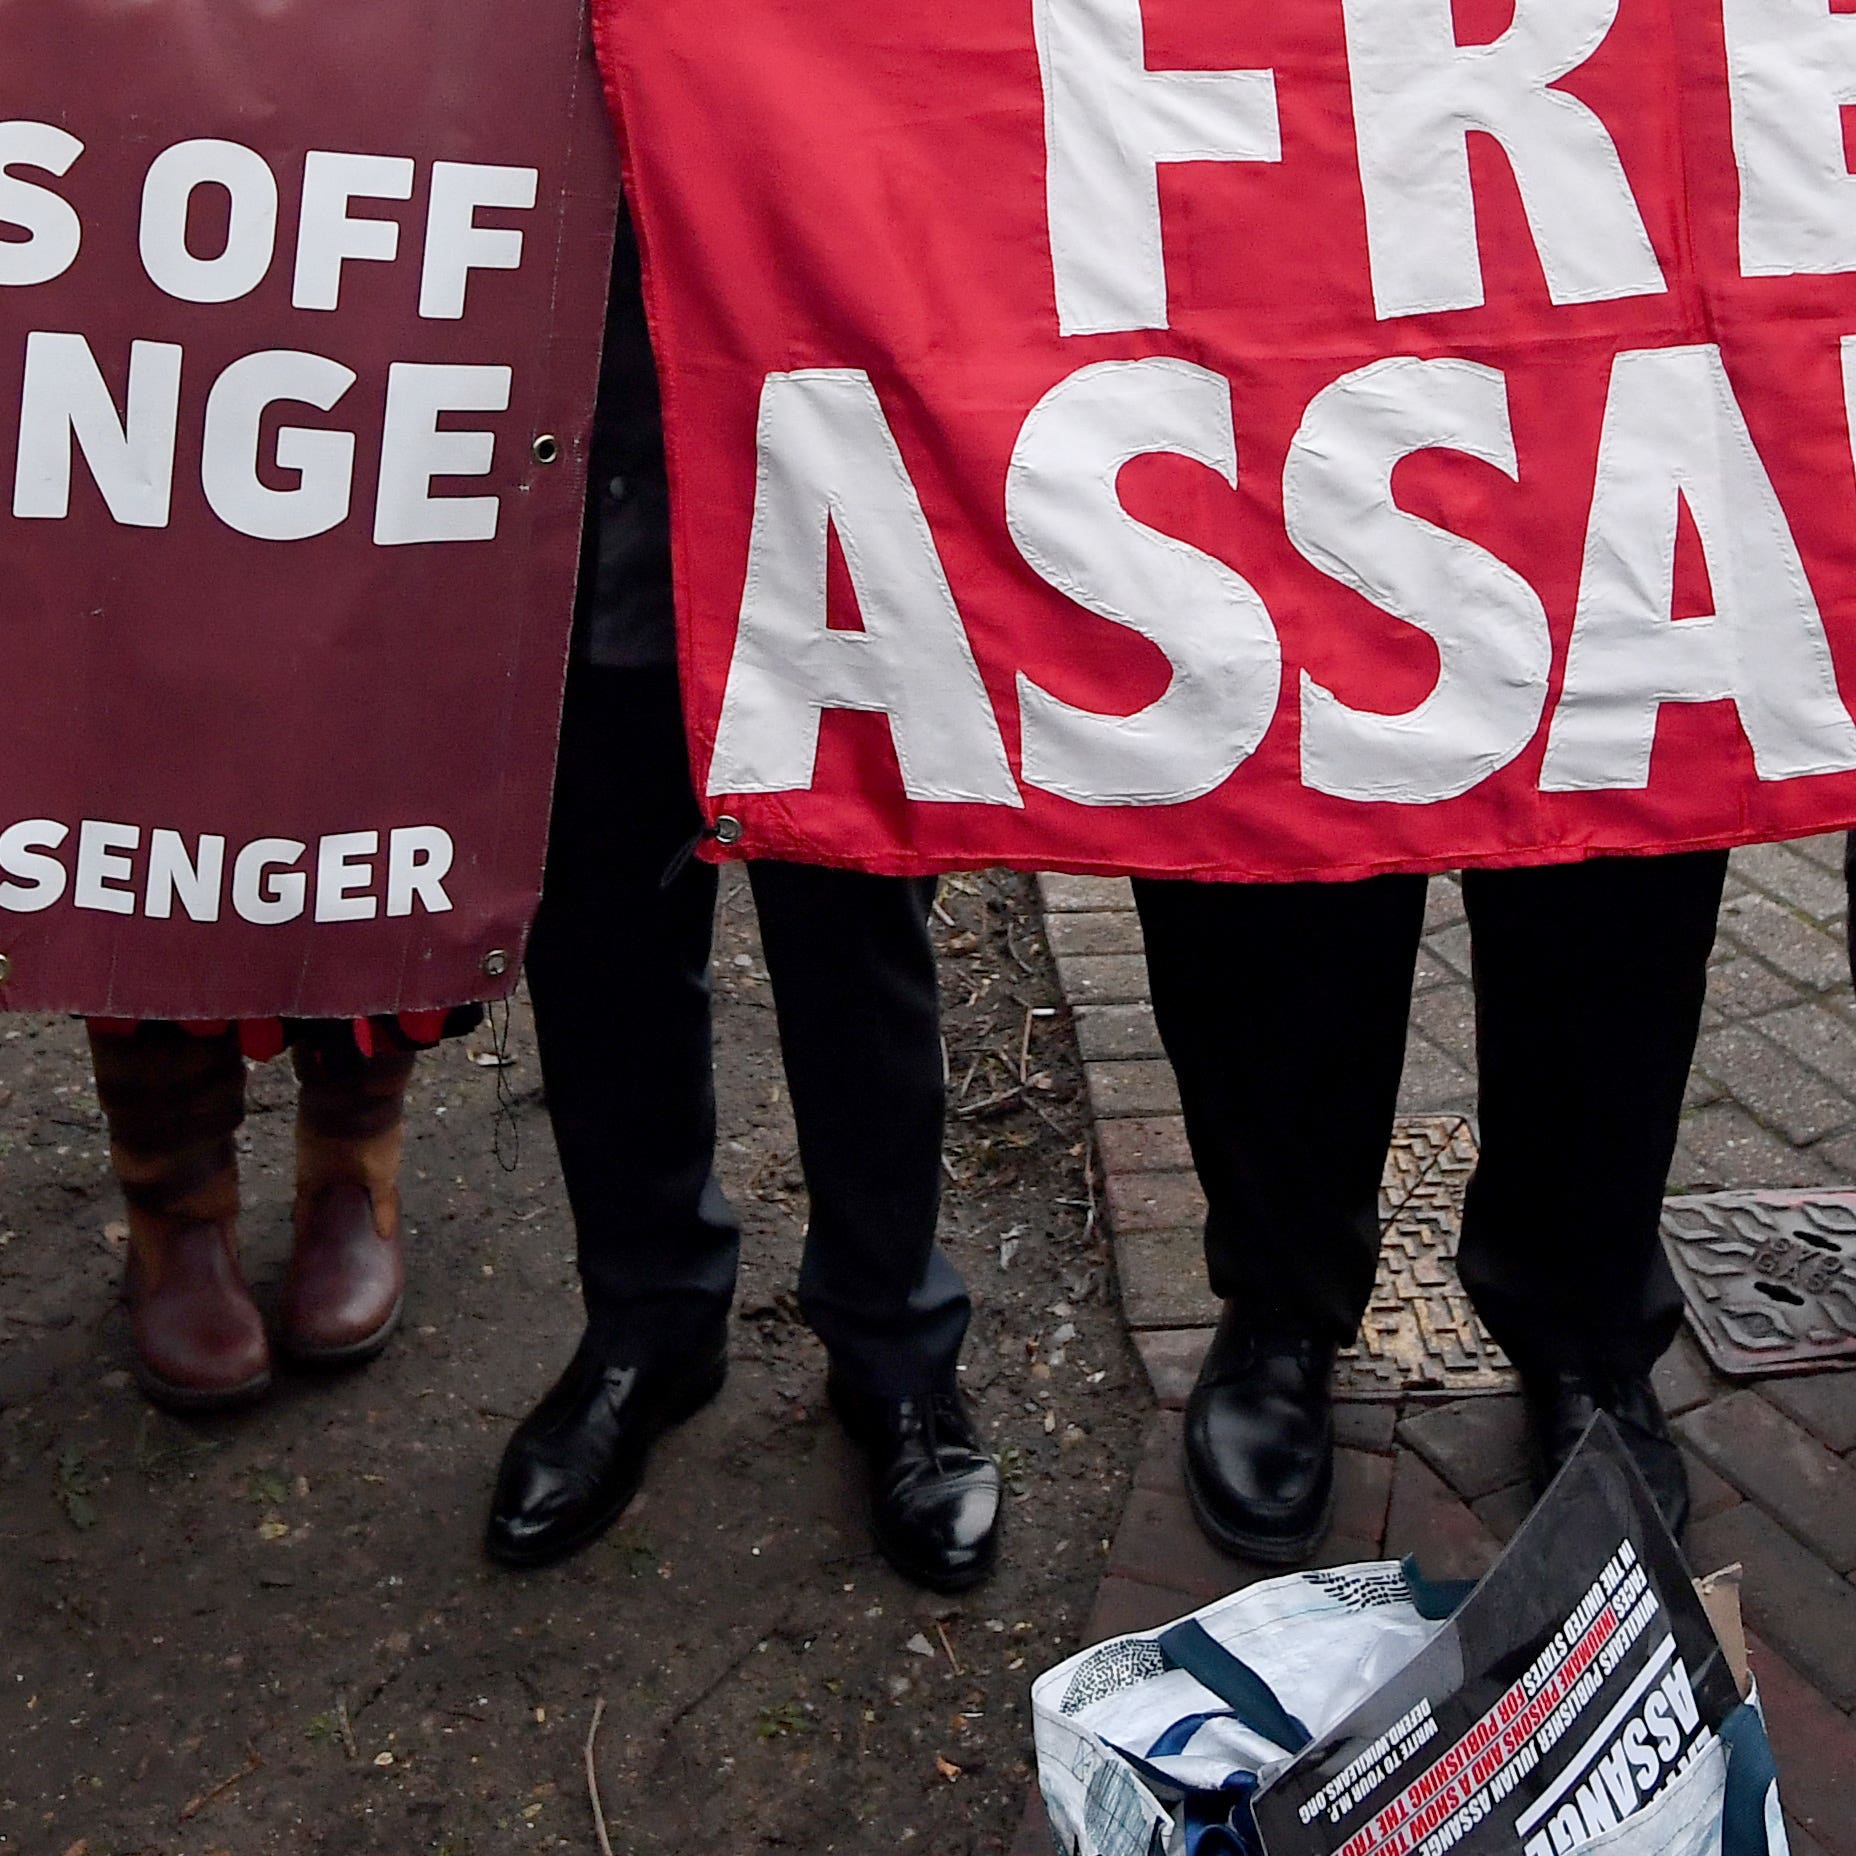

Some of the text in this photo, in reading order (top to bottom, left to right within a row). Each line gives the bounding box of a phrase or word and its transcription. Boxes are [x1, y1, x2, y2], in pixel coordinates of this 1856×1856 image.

[140, 138, 539, 319] OFF
[1611, 1563, 1647, 1619] FACES
[1557, 1605, 1617, 1692] INHUMANE
[1335, 1538, 1637, 1856] IN THE UNITED STATES FOR PUBLISHING THE TRU
[1418, 1588, 1659, 1856] WIKILEAKS PUBLISHER JULIAN ASSANGE
[1503, 1679, 1560, 1755] PRISONS
[1298, 1696, 1432, 1825] DEFEND.WIKILEAKS.ORG
[1383, 1750, 1402, 1775] TO
[1398, 1716, 1438, 1761] WRITE
[1471, 1742, 1503, 1785] AND
[1350, 1764, 1386, 1803] YOUR
[1457, 1771, 1472, 1797] A
[1409, 1785, 1460, 1844] SHOW
